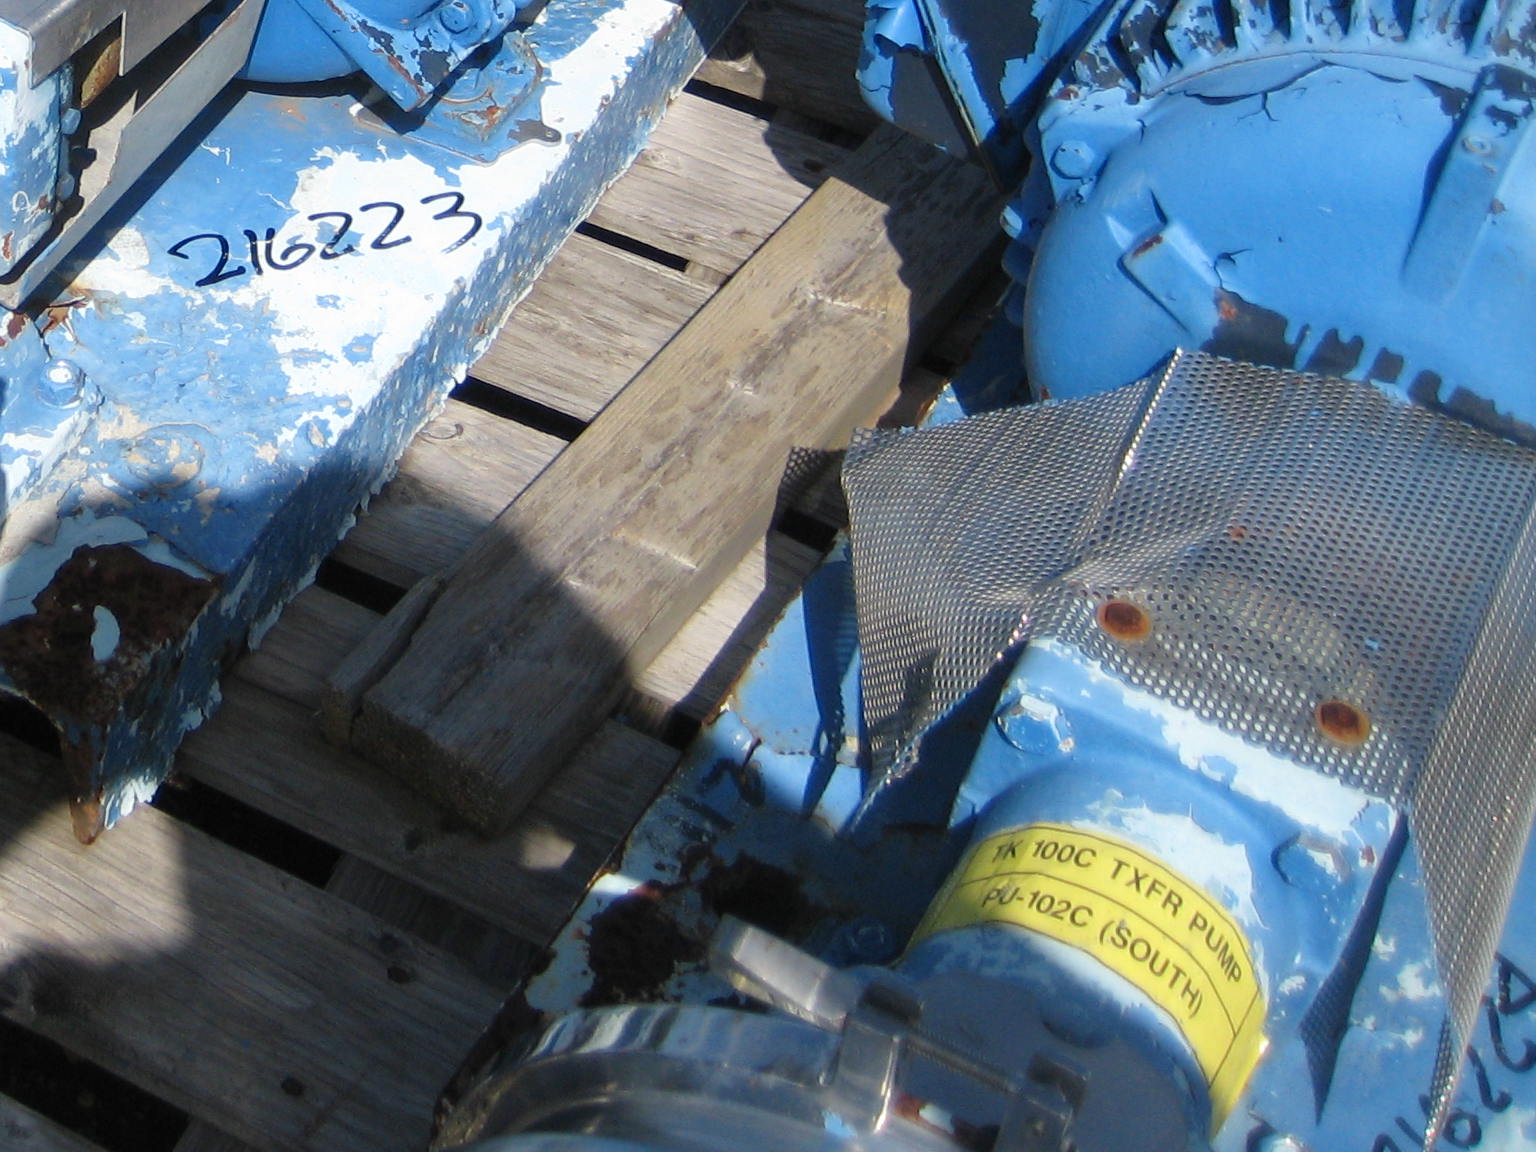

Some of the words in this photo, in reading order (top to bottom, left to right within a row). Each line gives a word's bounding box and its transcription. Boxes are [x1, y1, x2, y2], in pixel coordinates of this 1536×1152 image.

[167, 191, 483, 287] 216223
[981, 887, 1094, 927] PU-102C
[1099, 919, 1204, 1019] (SOUTH)
[991, 839, 1024, 864] TK
[1032, 839, 1097, 868] 100C
[1110, 858, 1183, 918] TXFR
[1188, 908, 1243, 984] PUMP
